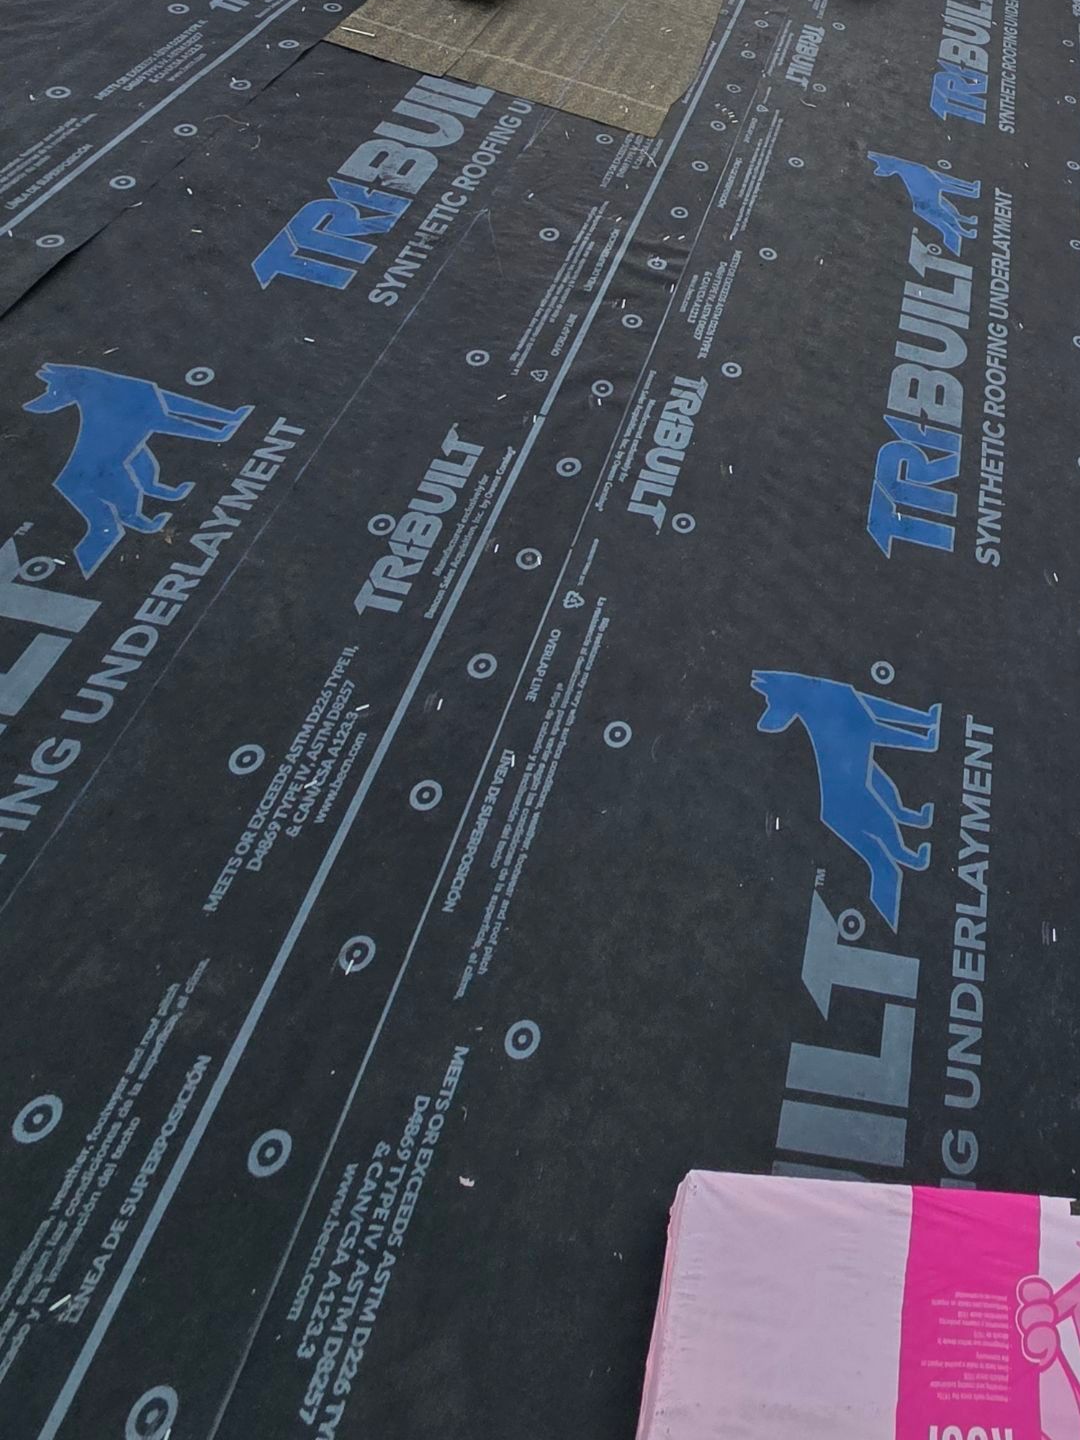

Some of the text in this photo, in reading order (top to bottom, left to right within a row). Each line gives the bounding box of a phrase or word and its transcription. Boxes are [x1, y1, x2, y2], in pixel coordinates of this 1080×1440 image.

[784, 23, 826, 91] TRIBUILT
[998, 70, 1017, 134] SYNTHETIC
[1001, 26, 1018, 72] ROOFING
[251, 74, 497, 290] TRIBUIL
[368, 113, 523, 307] SYNTHETIC ROOFING
[626, 375, 709, 530] TRIBUILT
[865, 228, 973, 554] TRIBUILT
[975, 187, 1013, 567] SYNTHETIC ROOFING UNDERLAYMENT
[61, 416, 307, 724] UNDERLAYMENT
[353, 427, 485, 616] TRIBUILT
[524, 628, 562, 703] OVERLAP LINE
[202, 856, 243, 912] MEETS
[234, 831, 258, 856] OR
[247, 763, 293, 830] EXCEEDS
[284, 723, 315, 765] ASTM
[305, 690, 333, 724] D226
[323, 656, 351, 688] TYPE
[245, 820, 282, 872] D4869
[272, 781, 308, 820] TYPE
[306, 720, 336, 762] ASTM
[326, 679, 356, 721] D8257
[292, 759, 337, 824] CAN/CSA
[327, 711, 359, 758] A123.3
[313, 731, 368, 824] www.becn.com
[484, 785, 501, 804] DE
[441, 799, 496, 913] SUPERPOSICIÓN
[943, 713, 997, 1110] UNDERLAYMENT
[101, 1218, 129, 1250] DE
[119, 1055, 212, 1217] SUPERPOSICIÓN
[372, 1163, 408, 1222] TYPE
[396, 1095, 431, 1161] D4869
[286, 1163, 359, 1322] www.becn.com
[296, 1140, 391, 1359] & CAN/CSA A123.3
[330, 1258, 370, 1333] ASTM
[333, 1045, 470, 1396] MEETS OR EXCEEDS ASTM D226
[299, 1336, 344, 1425] D8257
